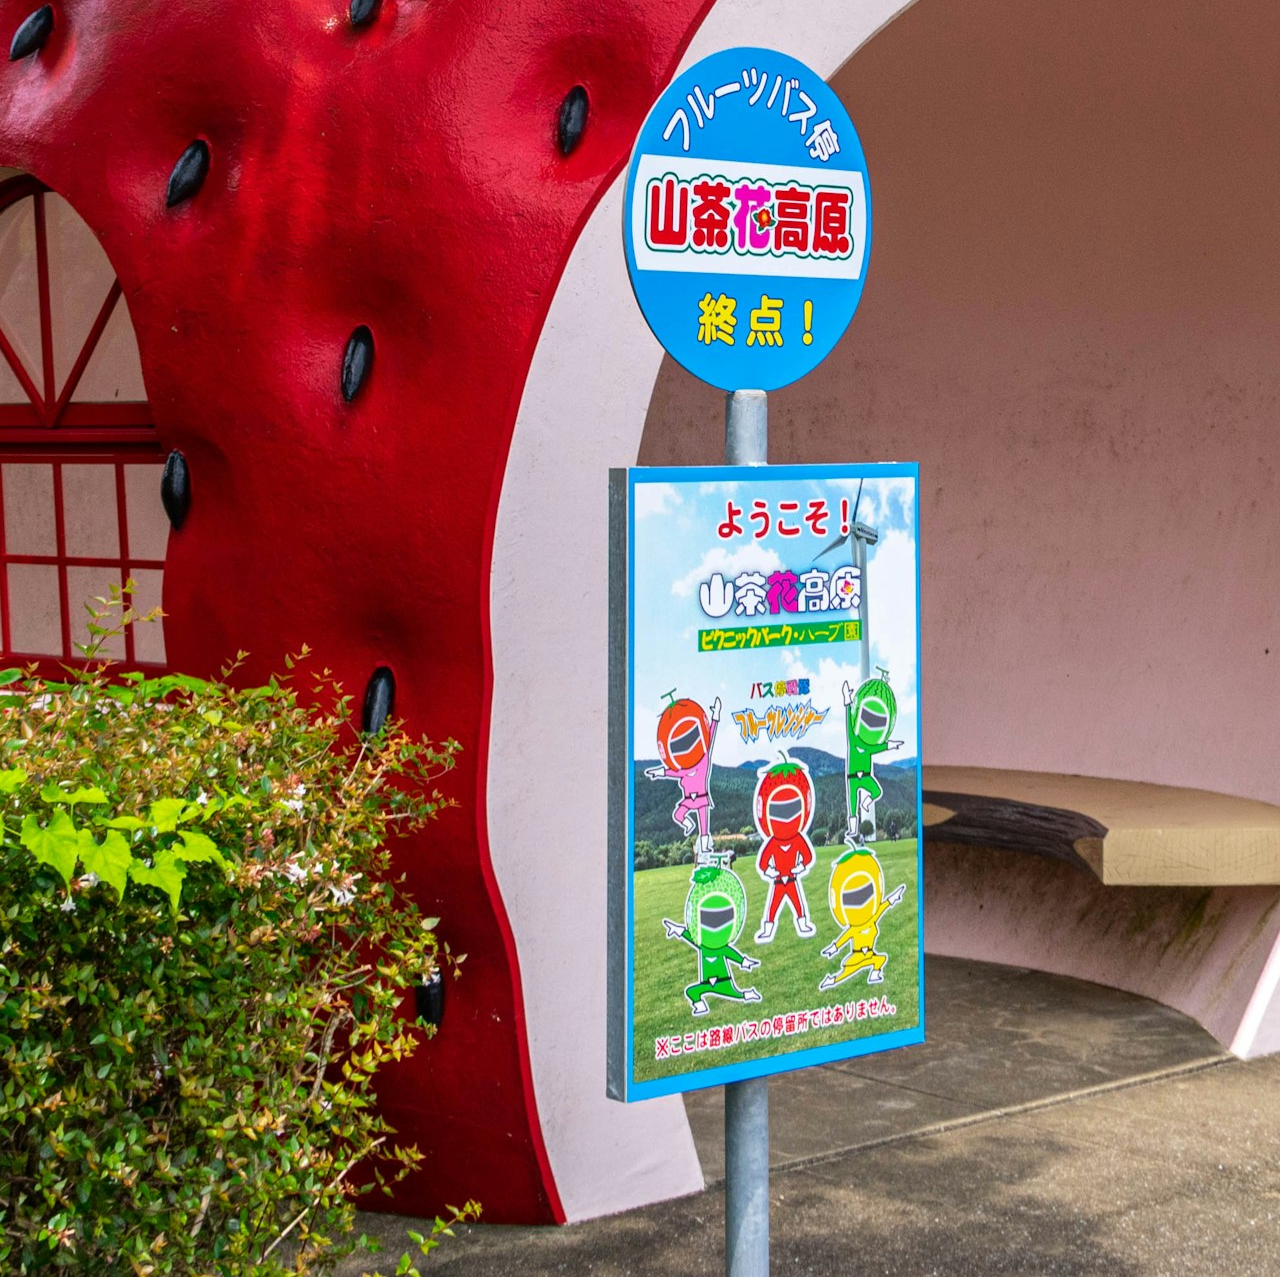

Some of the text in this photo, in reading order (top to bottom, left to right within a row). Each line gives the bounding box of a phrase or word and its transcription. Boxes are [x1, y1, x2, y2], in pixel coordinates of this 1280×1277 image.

[663, 67, 841, 162] フルーツバス停
[648, 177, 851, 257] 山茶花高原
[696, 291, 814, 347] 終点！
[716, 498, 851, 539] ようこそ！
[699, 566, 862, 618] 山茶花高原
